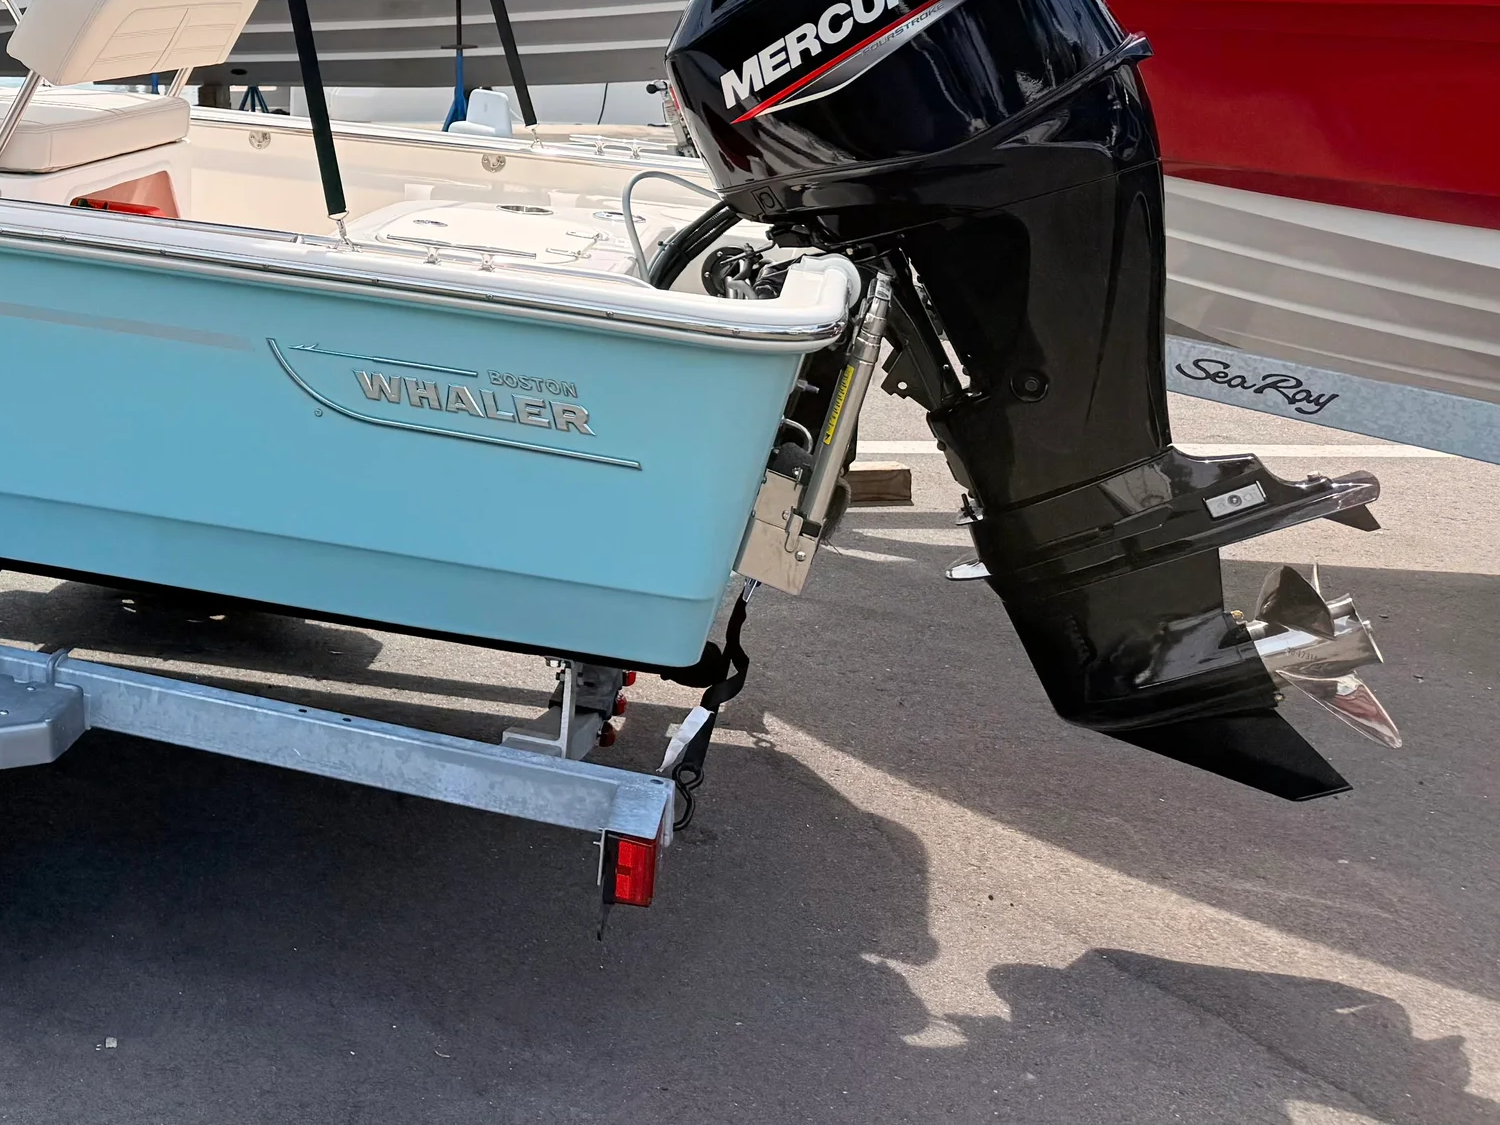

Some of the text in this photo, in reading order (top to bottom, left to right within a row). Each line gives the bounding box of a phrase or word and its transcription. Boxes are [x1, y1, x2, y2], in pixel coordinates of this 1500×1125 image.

[860, 2, 945, 56] FOURSTROKE
[350, 367, 597, 437] WHALER
[486, 369, 579, 399] BOSTON
[1175, 358, 1340, 415] Sea Ray
